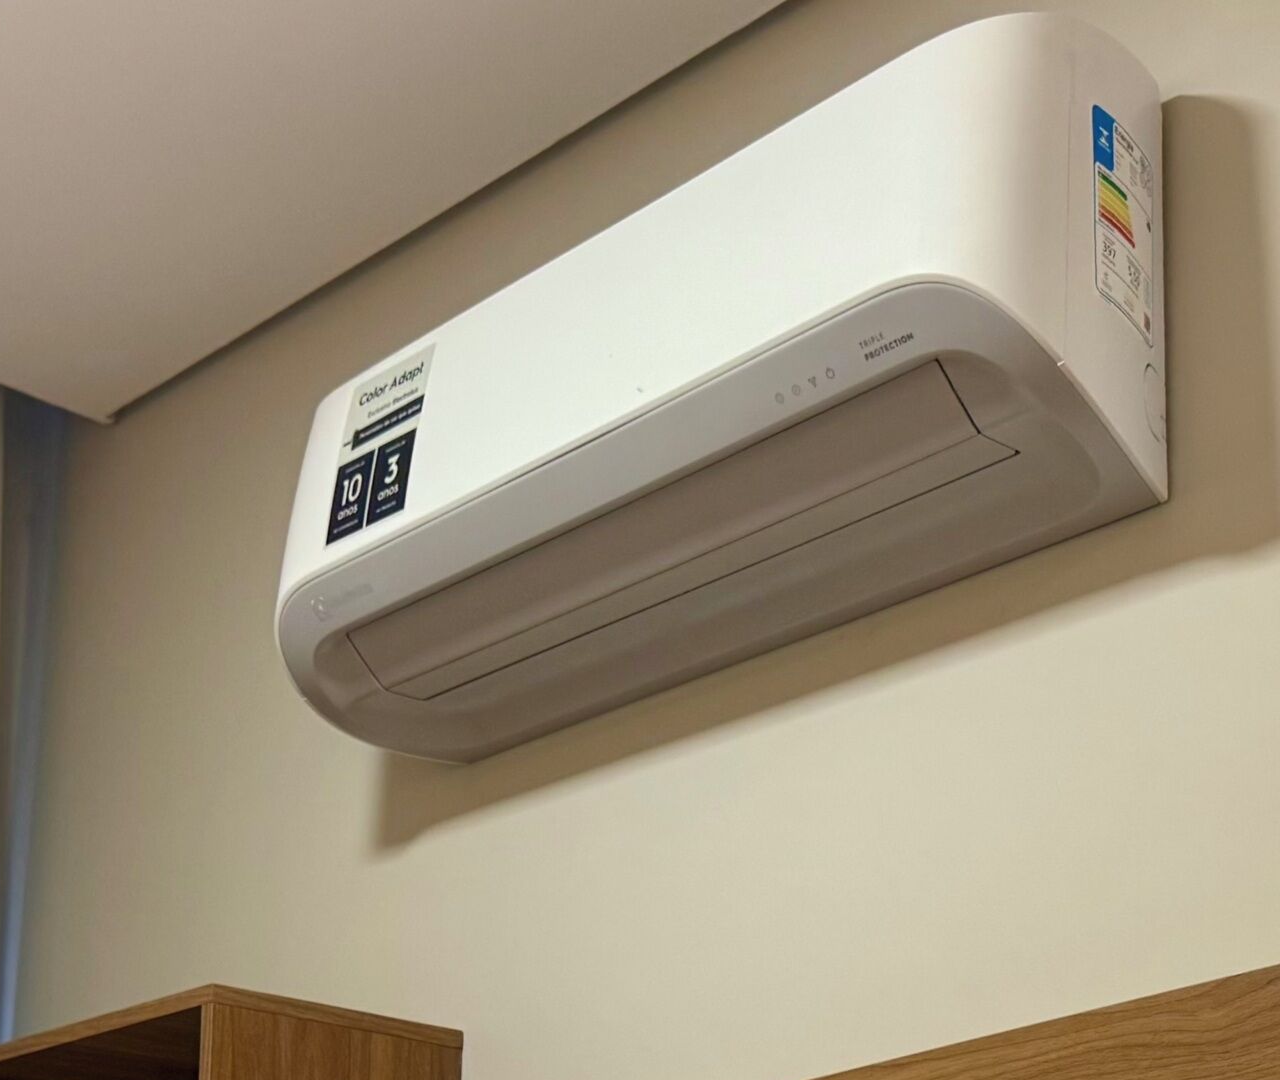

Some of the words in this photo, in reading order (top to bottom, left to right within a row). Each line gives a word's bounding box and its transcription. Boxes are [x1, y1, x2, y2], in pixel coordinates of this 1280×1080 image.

[858, 332, 884, 349] TRIPLE
[864, 333, 914, 361] PROTECTION
[359, 383, 388, 407] Color
[389, 361, 424, 391] Adapt
[384, 453, 400, 484] 3
[341, 473, 363, 507] 10
[377, 484, 399, 501] anos
[337, 504, 358, 520] anos
